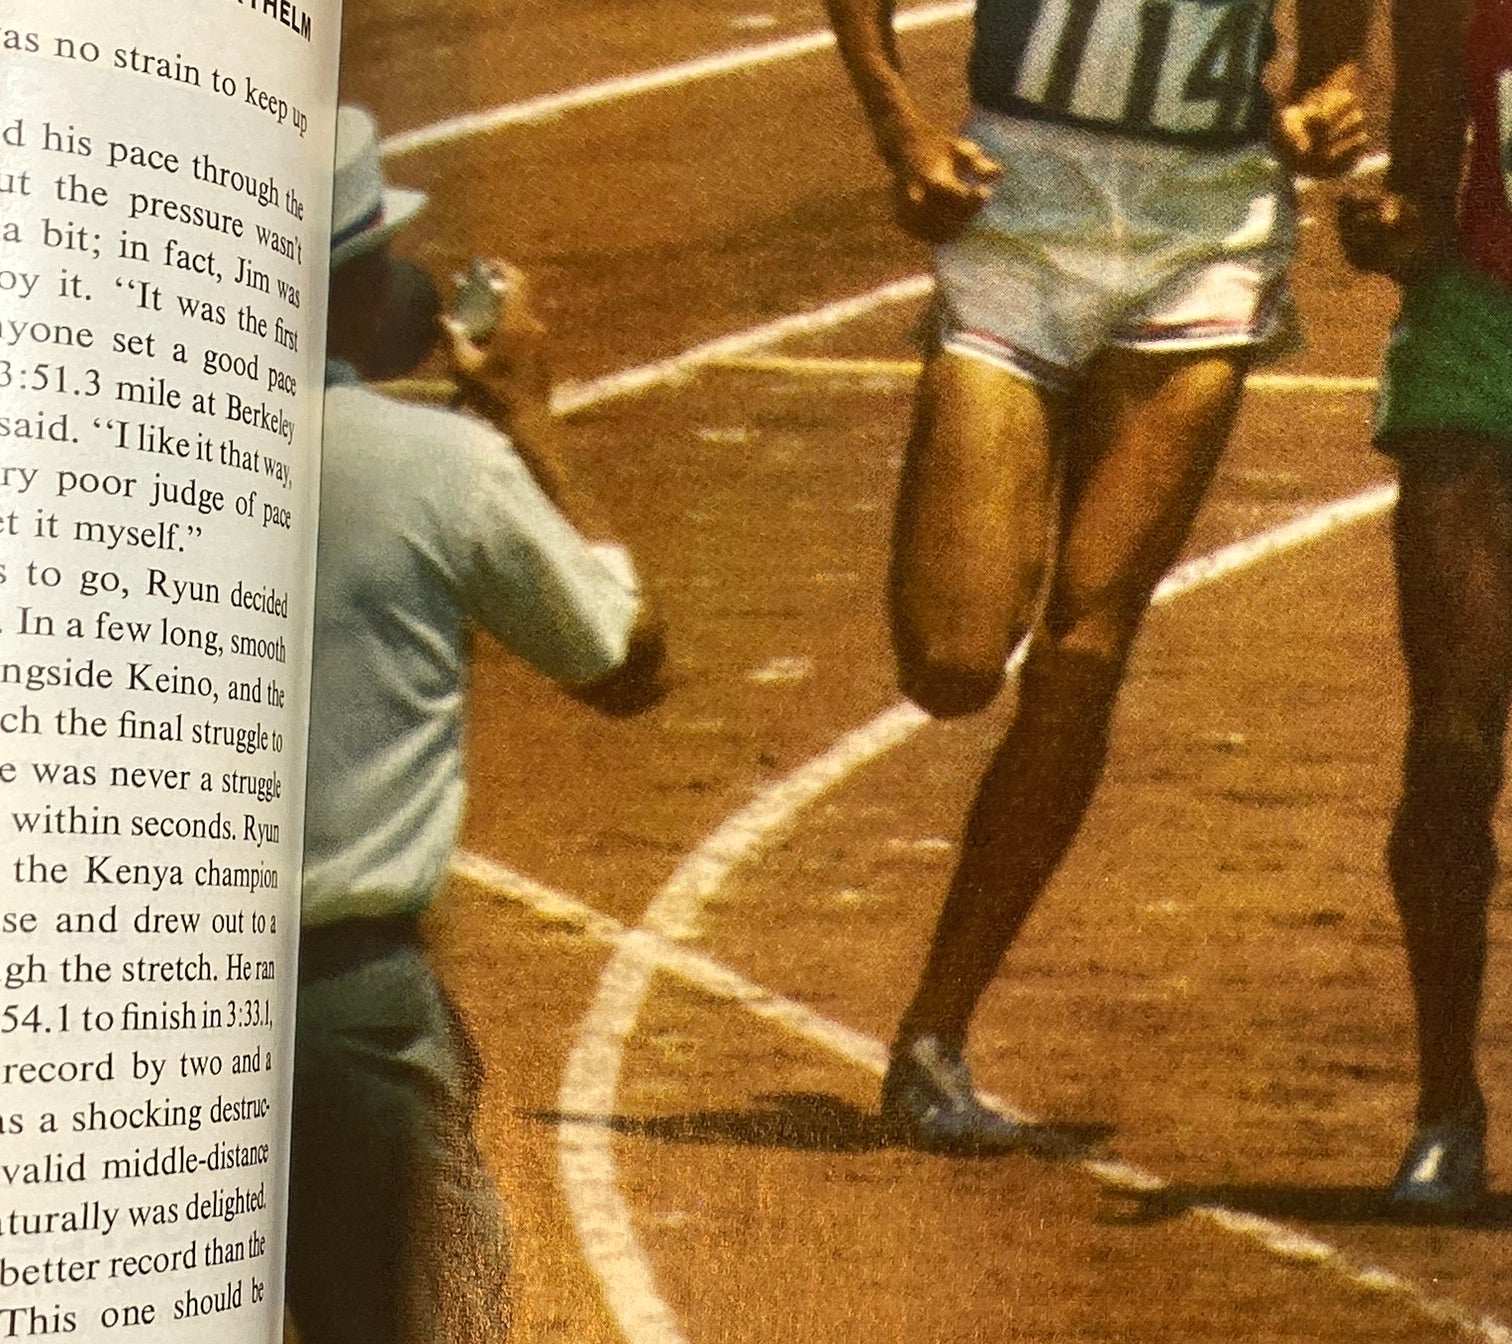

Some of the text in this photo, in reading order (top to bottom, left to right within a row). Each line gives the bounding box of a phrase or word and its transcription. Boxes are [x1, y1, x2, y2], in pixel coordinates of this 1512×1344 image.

[55, 37, 308, 137] no strain to keep up
[42, 122, 303, 221] his pace through the
[55, 174, 108, 205] the
[128, 192, 243, 237] pressure
[3, 219, 300, 308] a bit; in fact, Jim was
[58, 269, 91, 301] it.
[177, 295, 226, 325] was
[238, 306, 266, 338] the
[275, 317, 297, 352] first
[113, 331, 296, 396] set a good pace
[0, 360, 295, 445] 3:51.3 mile at Berkeley
[0, 411, 78, 443] said.
[138, 423, 190, 457] like
[196, 433, 213, 462] it
[220, 439, 259, 473] that
[263, 455, 292, 490] way,
[35, 508, 58, 538] it
[57, 469, 291, 530] poor judge of pace
[28, 561, 288, 618] to go, Ryun decided
[16, 607, 286, 663] In a few long, smooth
[127, 662, 218, 703] Keino,
[228, 678, 262, 703] and
[267, 680, 284, 709] the
[55, 707, 282, 754] the final struggle to
[32, 761, 281, 802] was never a struggle
[11, 805, 279, 847] within seconds. Ryun
[14, 854, 278, 893] the Kenya champion
[56, 905, 276, 934] and drew out to a
[60, 953, 274, 982] the stretch. He ran
[1, 1003, 70, 1034] 54.1
[82, 1006, 113, 1032] to
[121, 1002, 197, 1031] finish
[201, 1002, 222, 1029] in
[3, 1045, 271, 1086] record by two and a
[39, 1095, 270, 1133] a shocking destruc-
[1, 1141, 269, 1184] valid middle-distance
[129, 1182, 266, 1226] was delighted.
[1, 1230, 265, 1287] better record than the
[0, 1277, 264, 1337] This one should be
